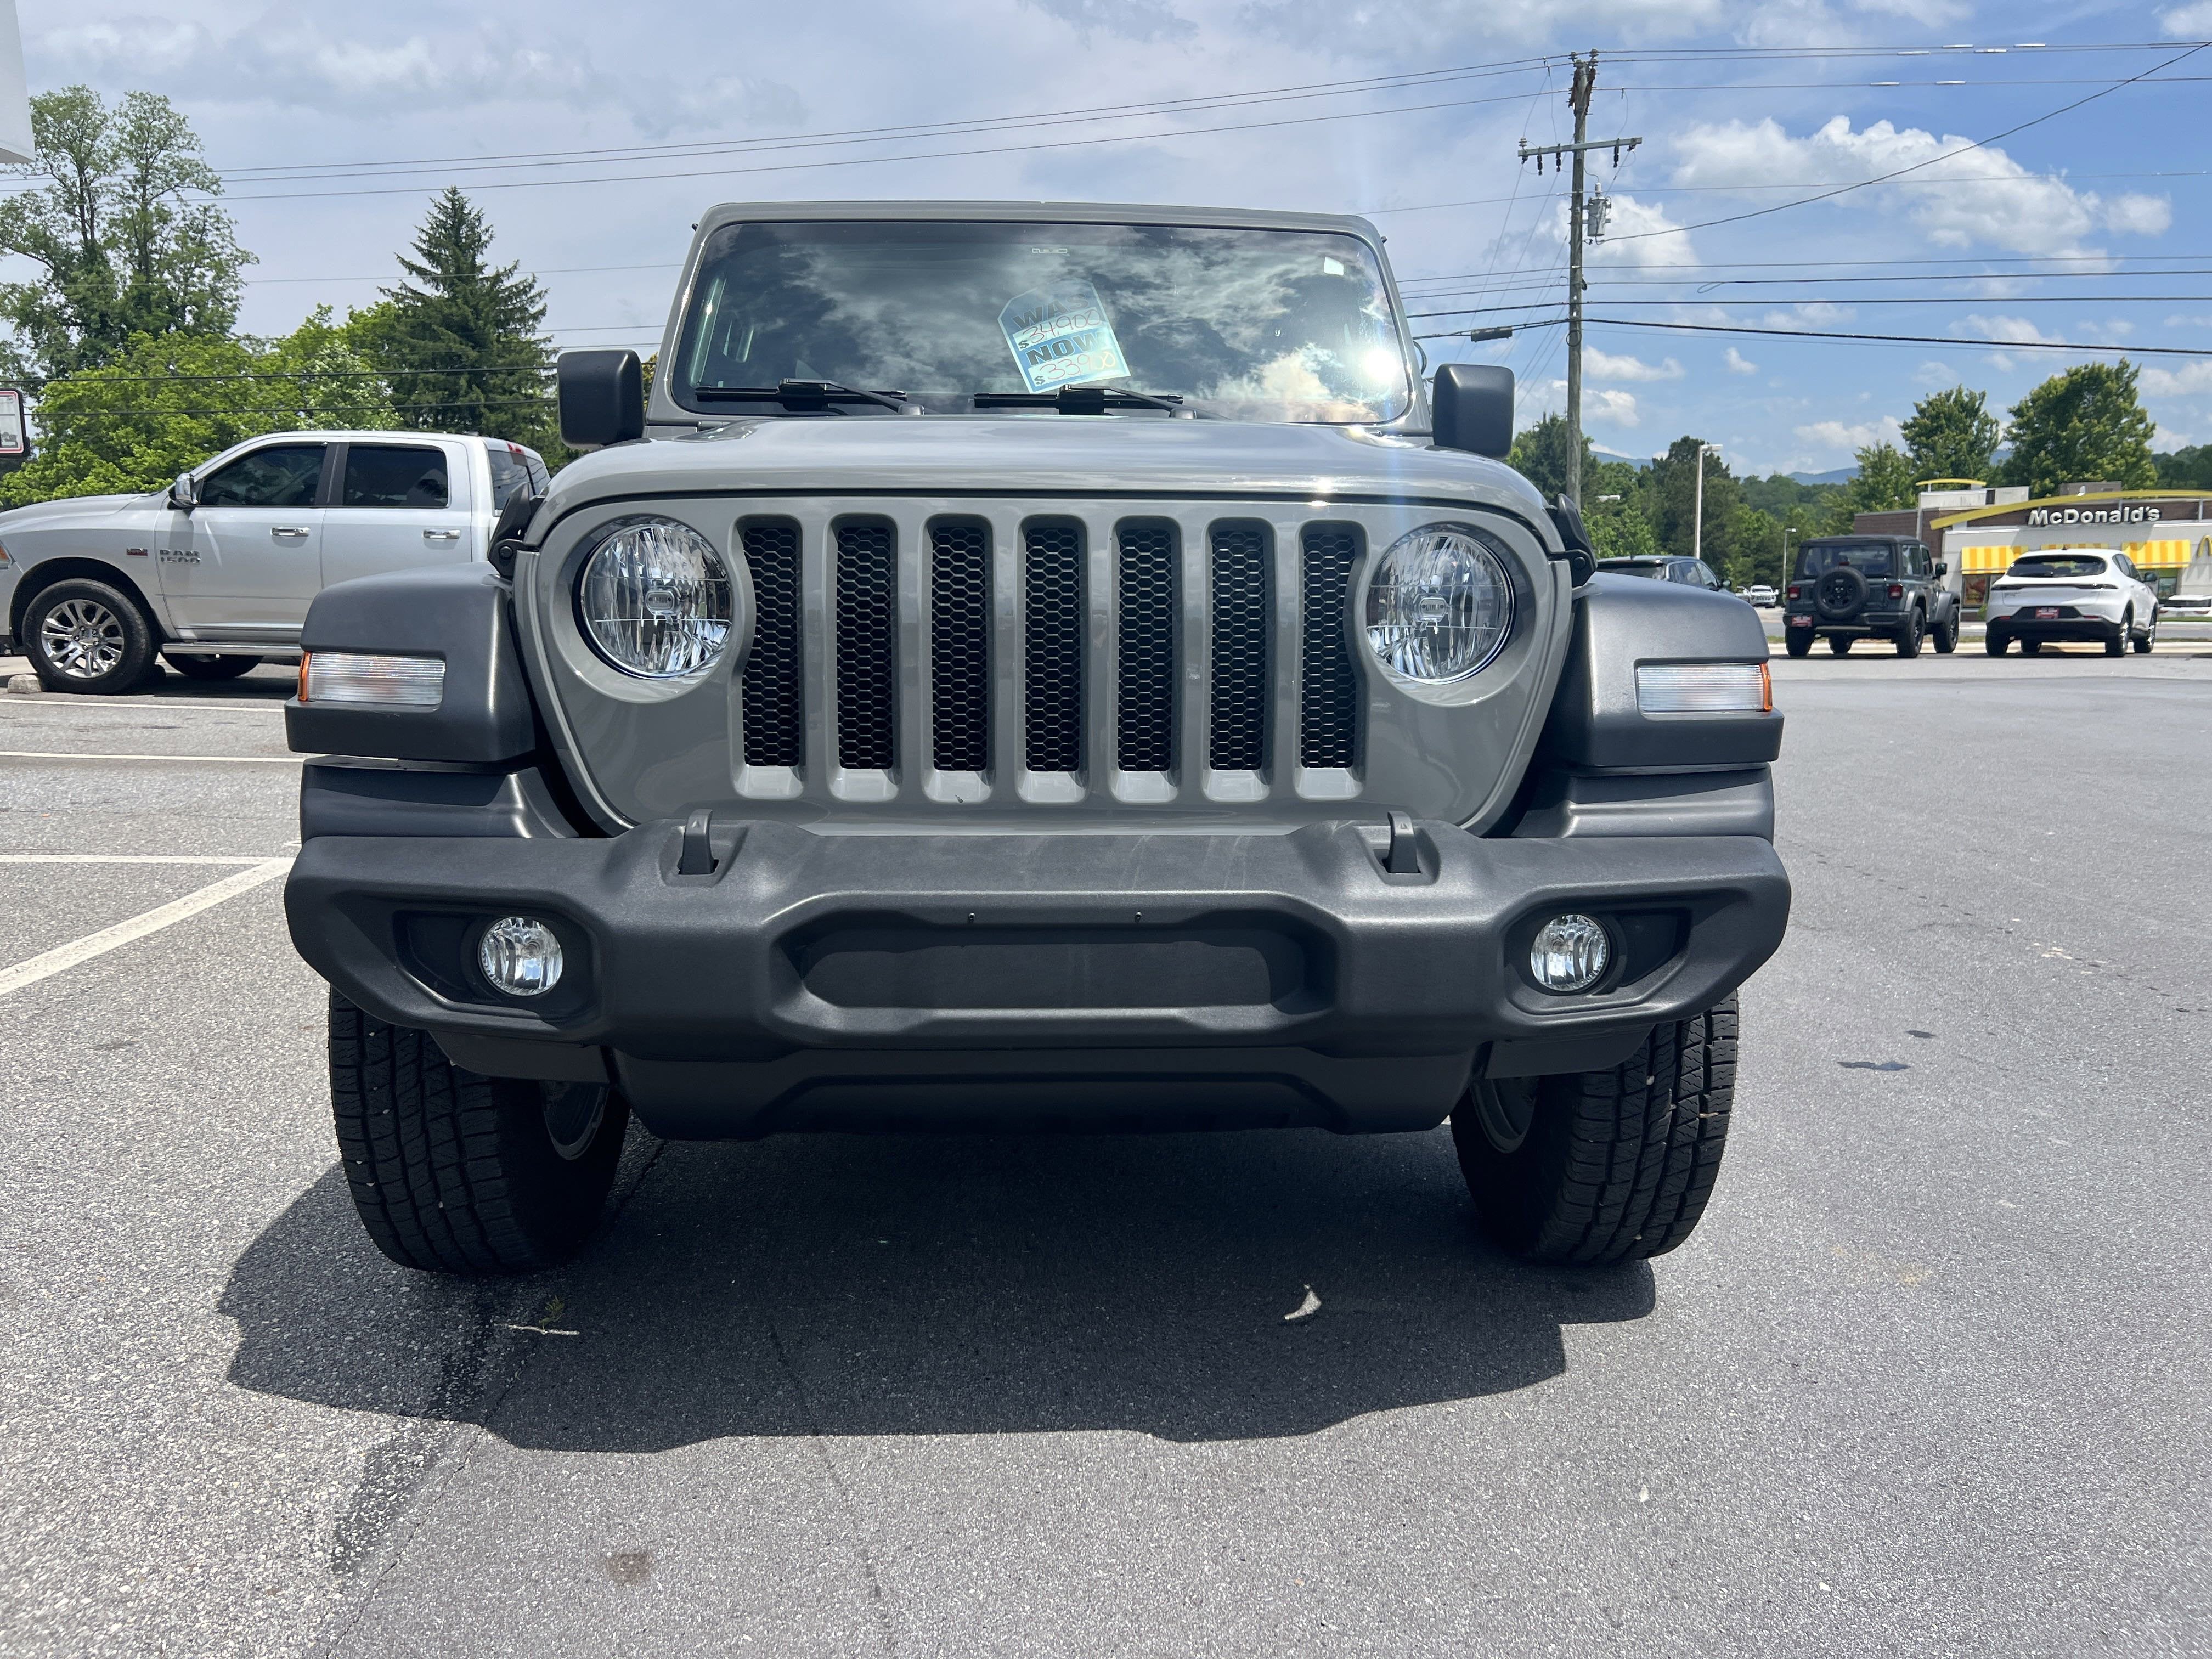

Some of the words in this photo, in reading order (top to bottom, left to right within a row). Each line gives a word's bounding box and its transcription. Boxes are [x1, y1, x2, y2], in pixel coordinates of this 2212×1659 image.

[1013, 294, 1090, 329] WAS
[1026, 331, 1102, 367] NOW
[2028, 506, 2161, 525] McDonald's
